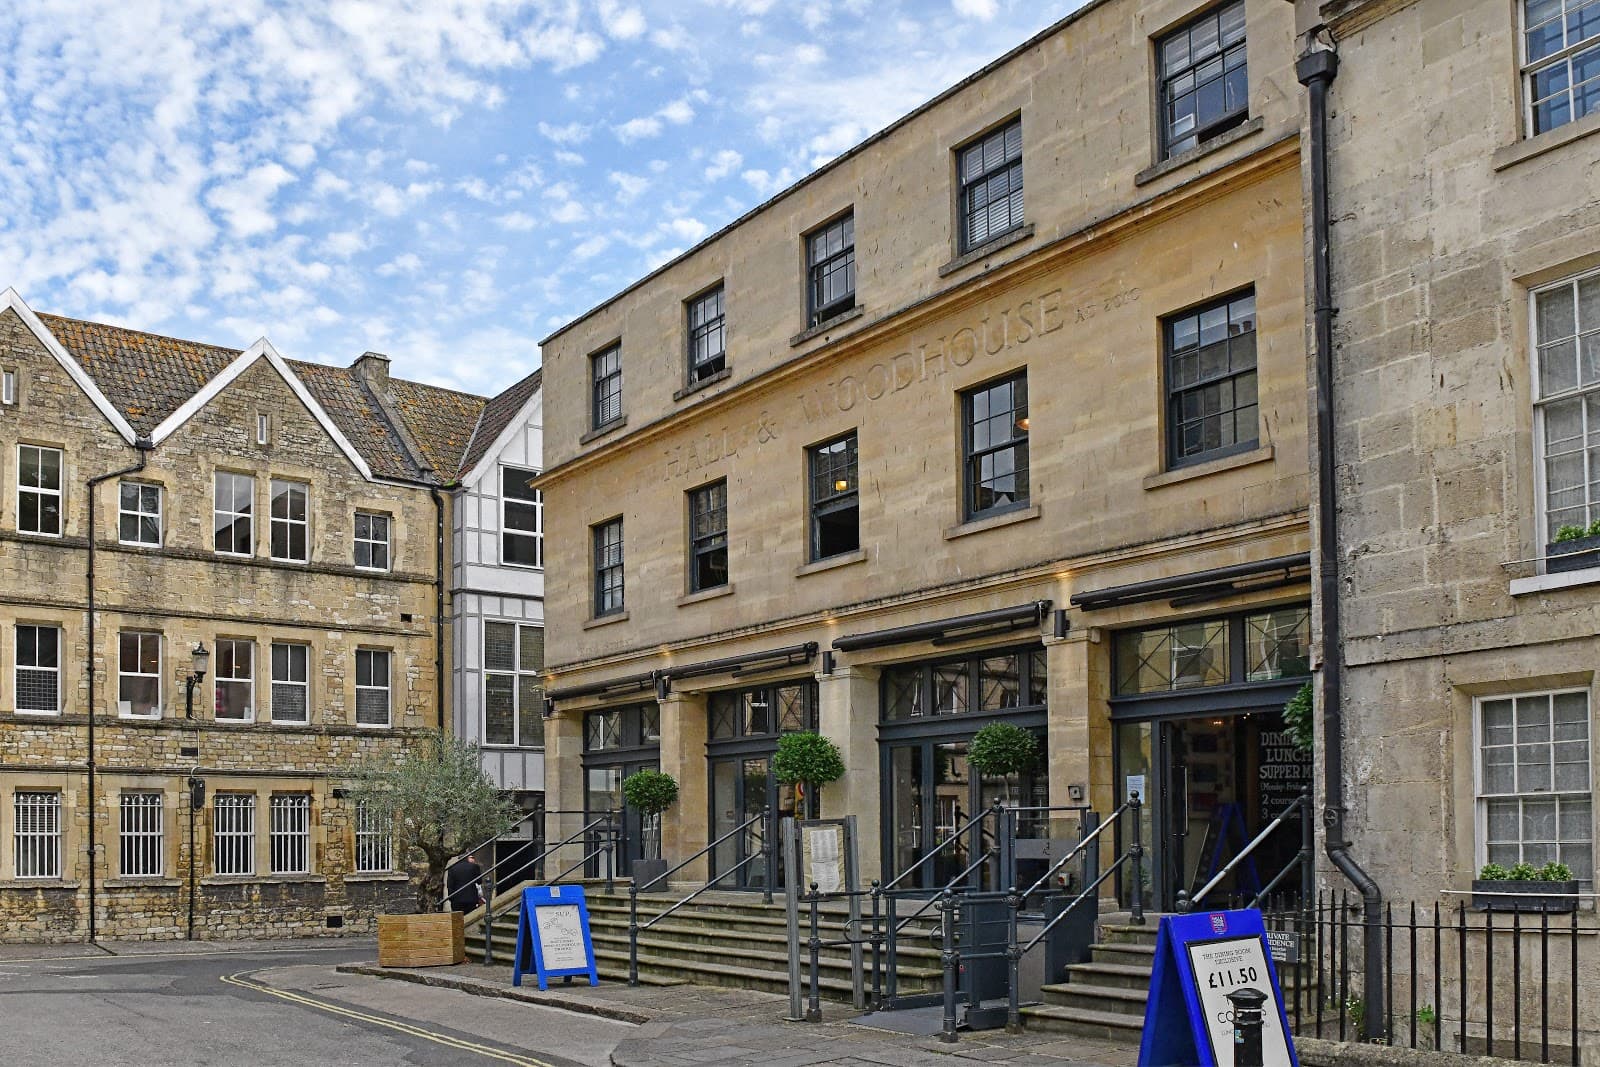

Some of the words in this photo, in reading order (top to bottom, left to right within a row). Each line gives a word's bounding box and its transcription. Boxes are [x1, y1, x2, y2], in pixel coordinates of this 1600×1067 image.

[664, 426, 739, 482] HALL
[756, 411, 778, 444] &
[797, 287, 1065, 425] WOODHOUSE
[1267, 749, 1312, 762] LUNCH
[1260, 765, 1300, 779] SUPPER
[1303, 765, 1313, 778] M
[1262, 794, 1269, 805] 2
[1262, 808, 1268, 819] 3
[1266, 932, 1290, 941] RIVATE
[1208, 967, 1257, 988] £11.50
